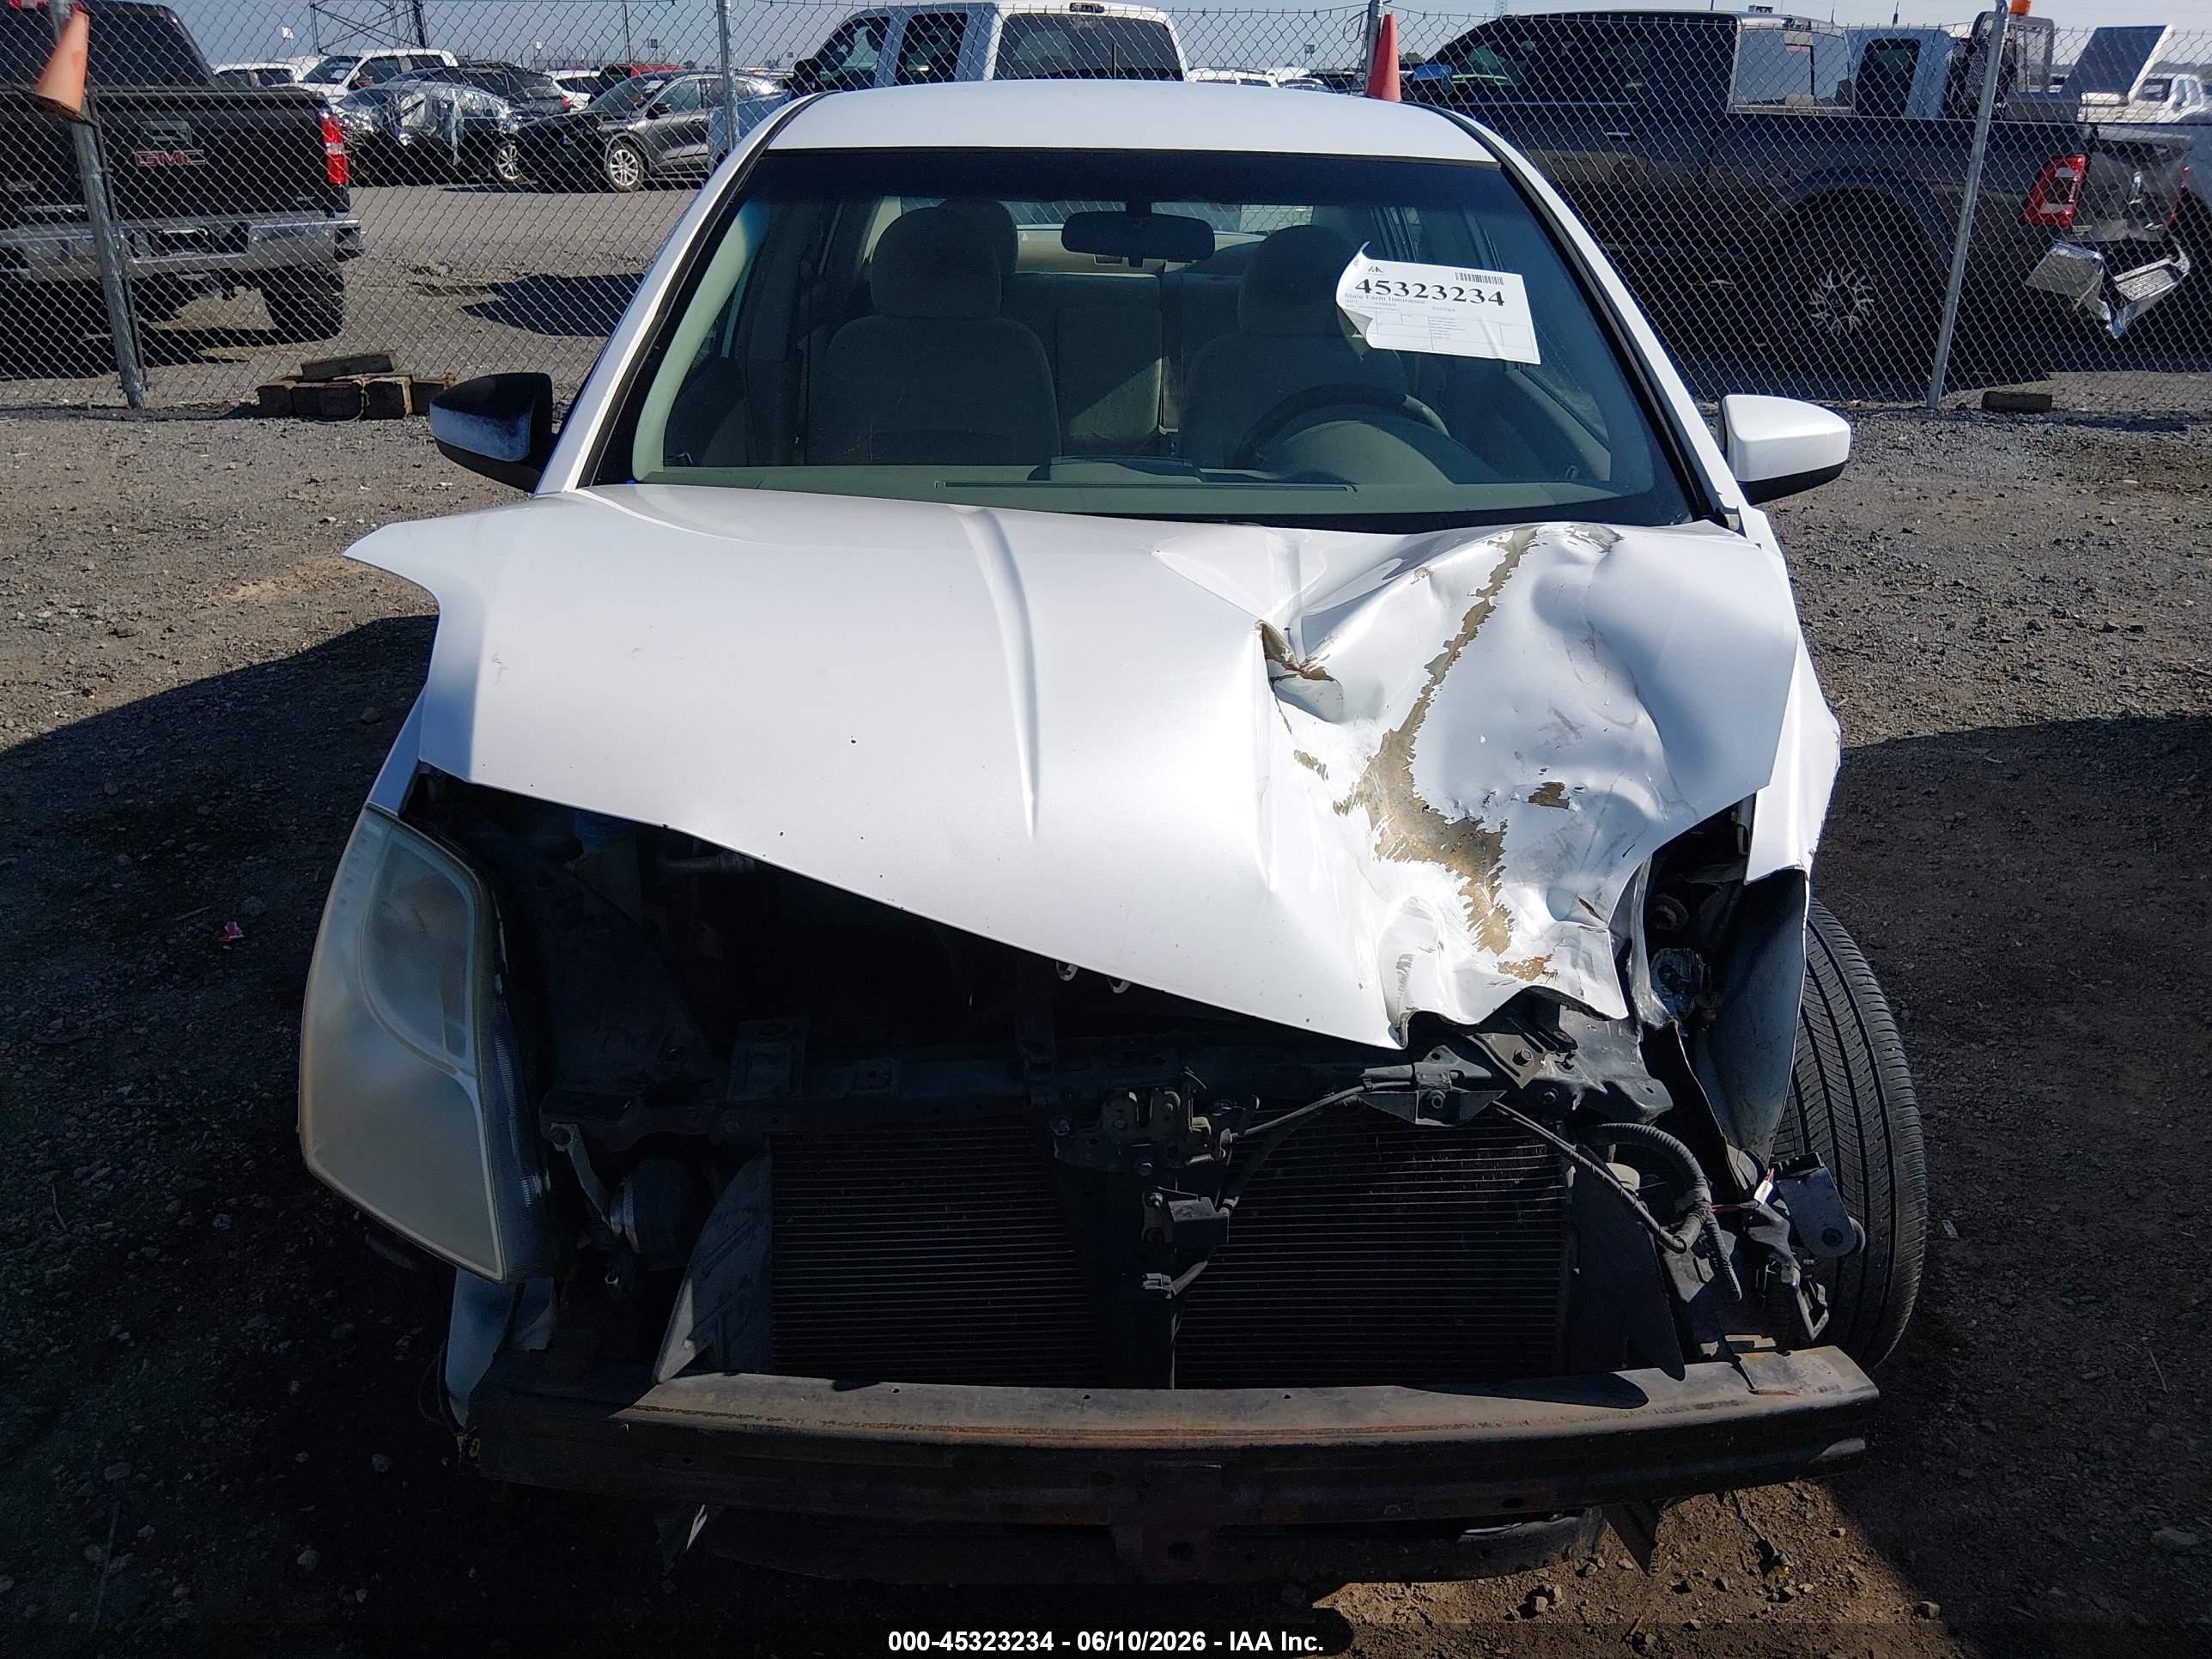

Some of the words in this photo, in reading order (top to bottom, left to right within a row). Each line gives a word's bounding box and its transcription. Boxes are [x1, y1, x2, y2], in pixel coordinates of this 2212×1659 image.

[135, 149, 205, 166] GMC
[1355, 278, 1505, 307] 45323234
[1389, 295, 1426, 304] Insurance
